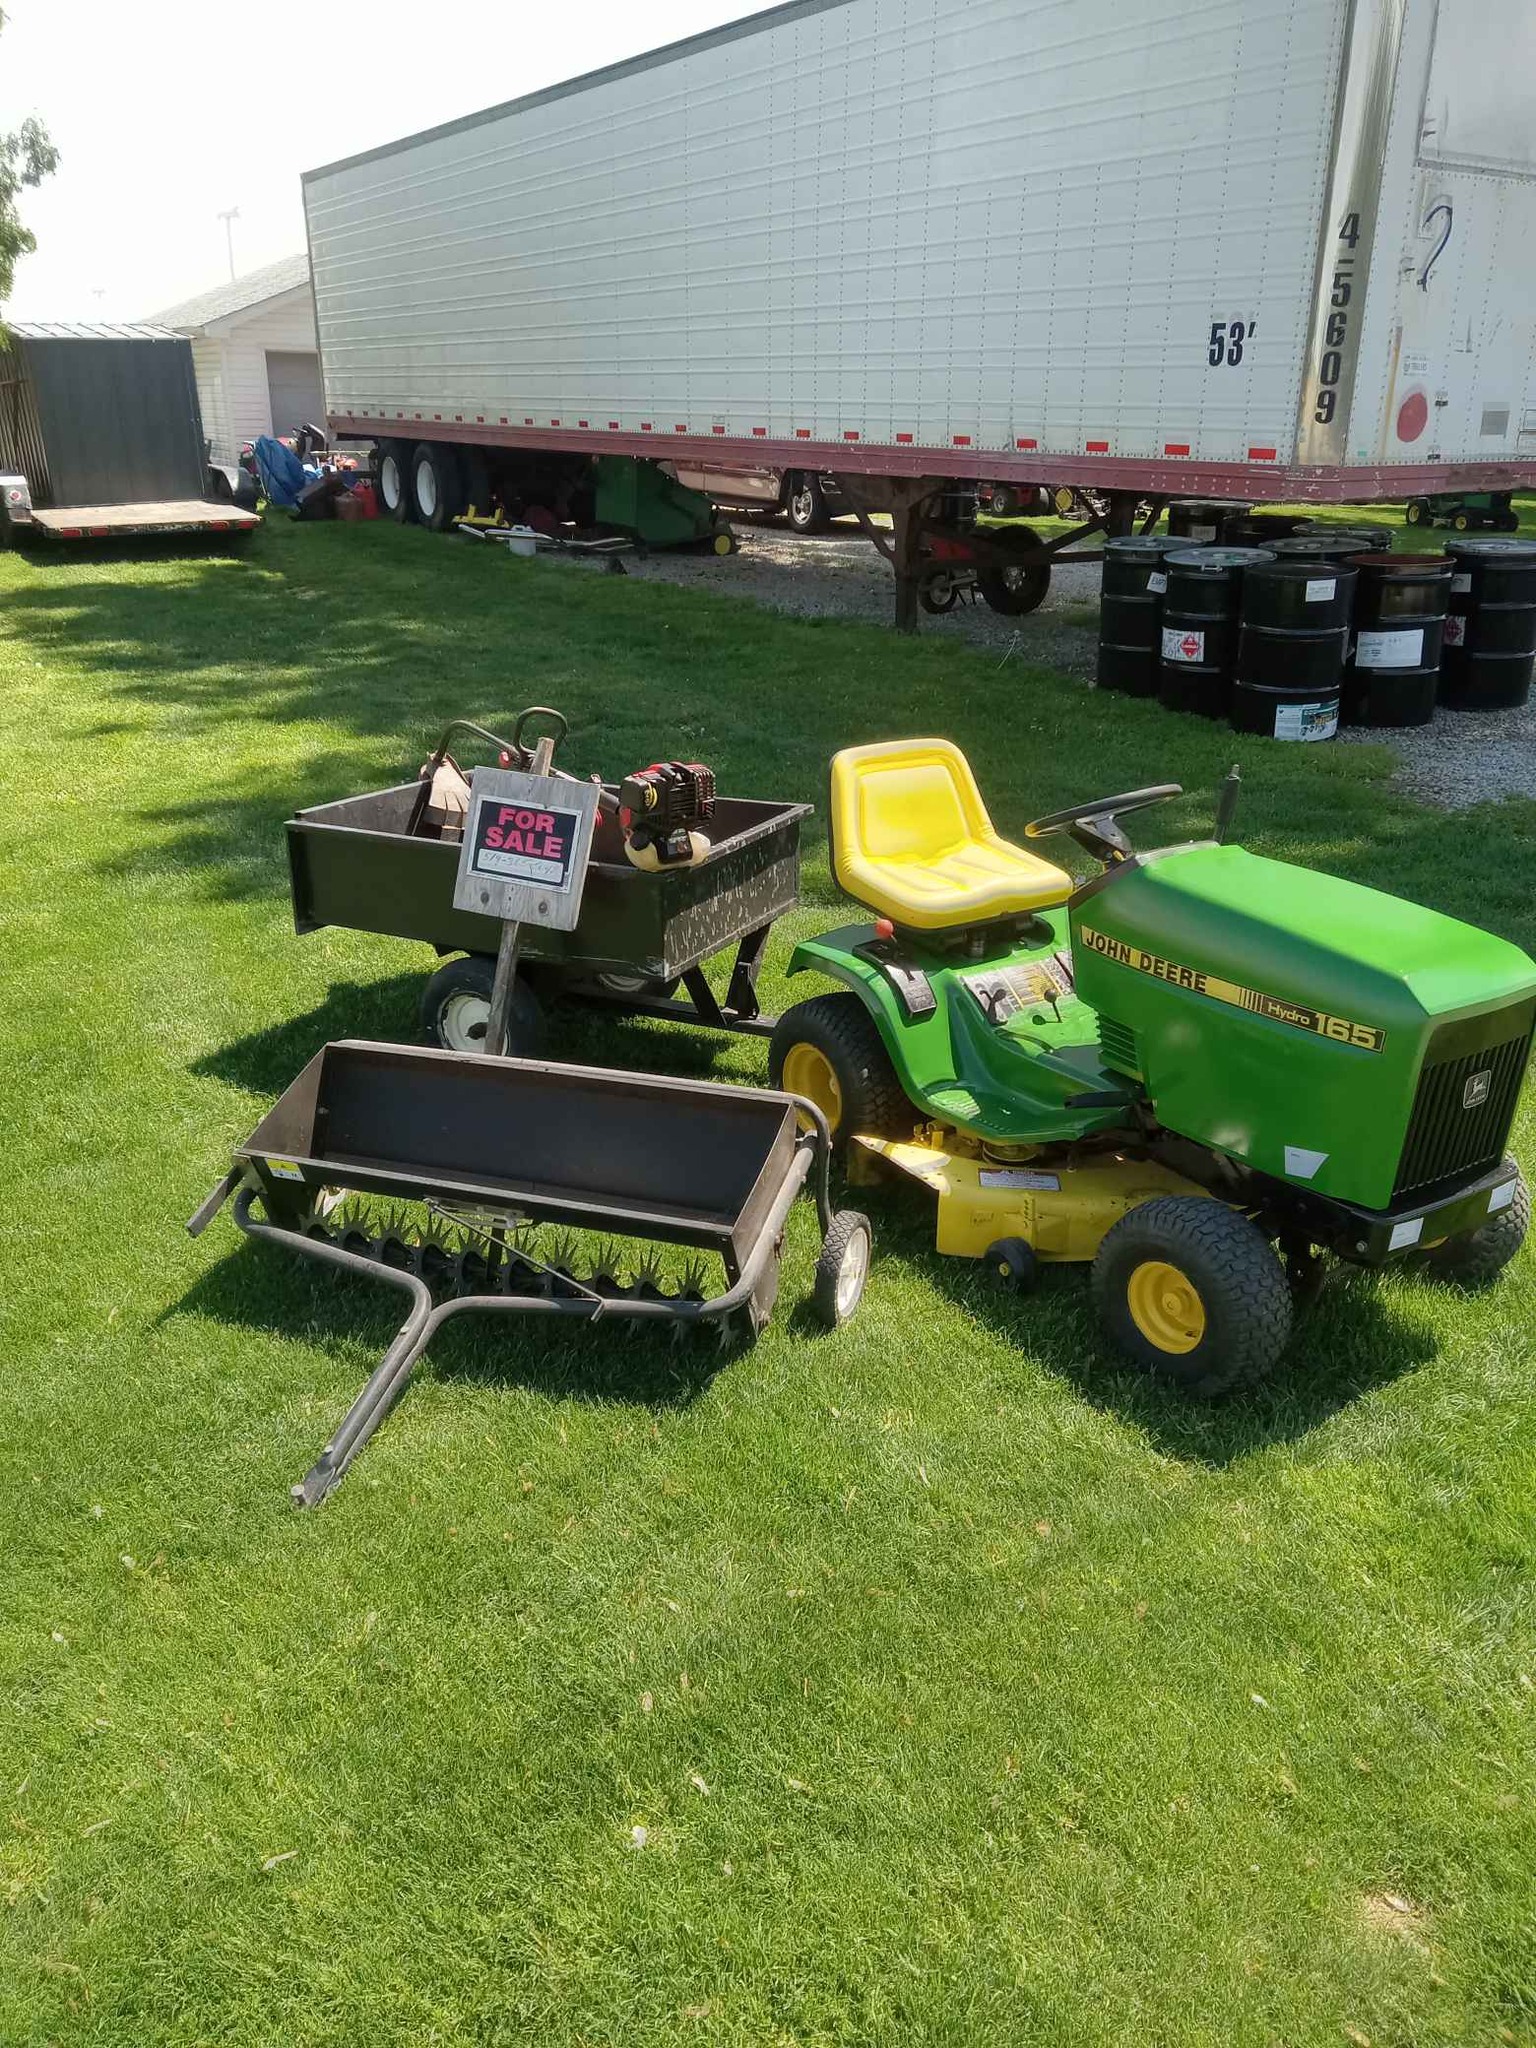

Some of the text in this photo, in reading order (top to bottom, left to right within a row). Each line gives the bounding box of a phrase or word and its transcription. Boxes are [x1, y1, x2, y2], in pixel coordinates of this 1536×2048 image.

[1315, 212, 1360, 424] 4-5609
[1208, 321, 1257, 366] 53'
[486, 826, 564, 858] SALE
[498, 807, 556, 833] FOR
[1086, 931, 1207, 993] JOHN DEERE
[1267, 1001, 1377, 1049] Hydro 165
